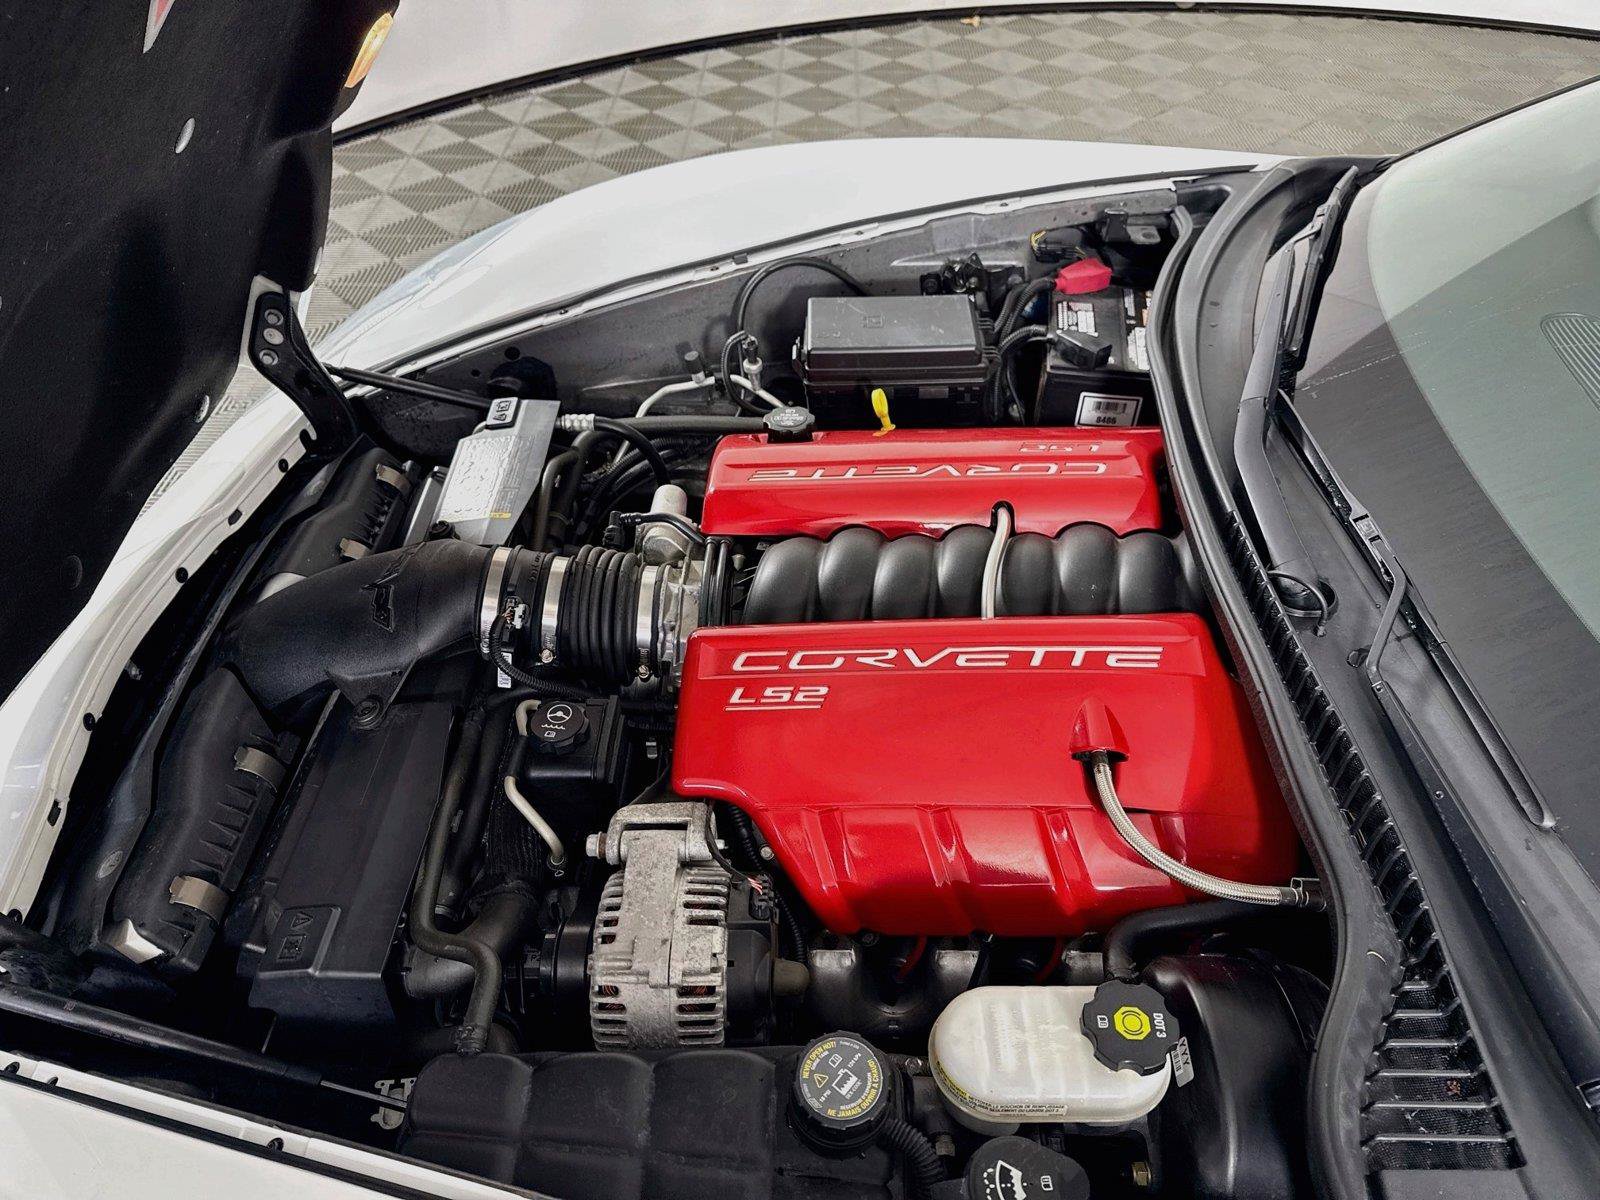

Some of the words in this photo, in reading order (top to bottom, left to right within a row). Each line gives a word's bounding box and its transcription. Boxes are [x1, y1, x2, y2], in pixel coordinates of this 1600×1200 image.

[747, 460, 1108, 482] CORVETTE
[732, 646, 1164, 673] CORVETTE
[726, 686, 830, 706] LS2
[1153, 1012, 1166, 1031] DOT
[803, 1059, 811, 1078] NEVER
[809, 1046, 824, 1061] OPEN
[822, 1041, 836, 1050] HOT!
[1180, 1038, 1190, 1065] YYY
[867, 1060, 878, 1081] CHAUD!
[859, 1089, 877, 1109] OUVRIR
[837, 1106, 861, 1116] JAMAIS
